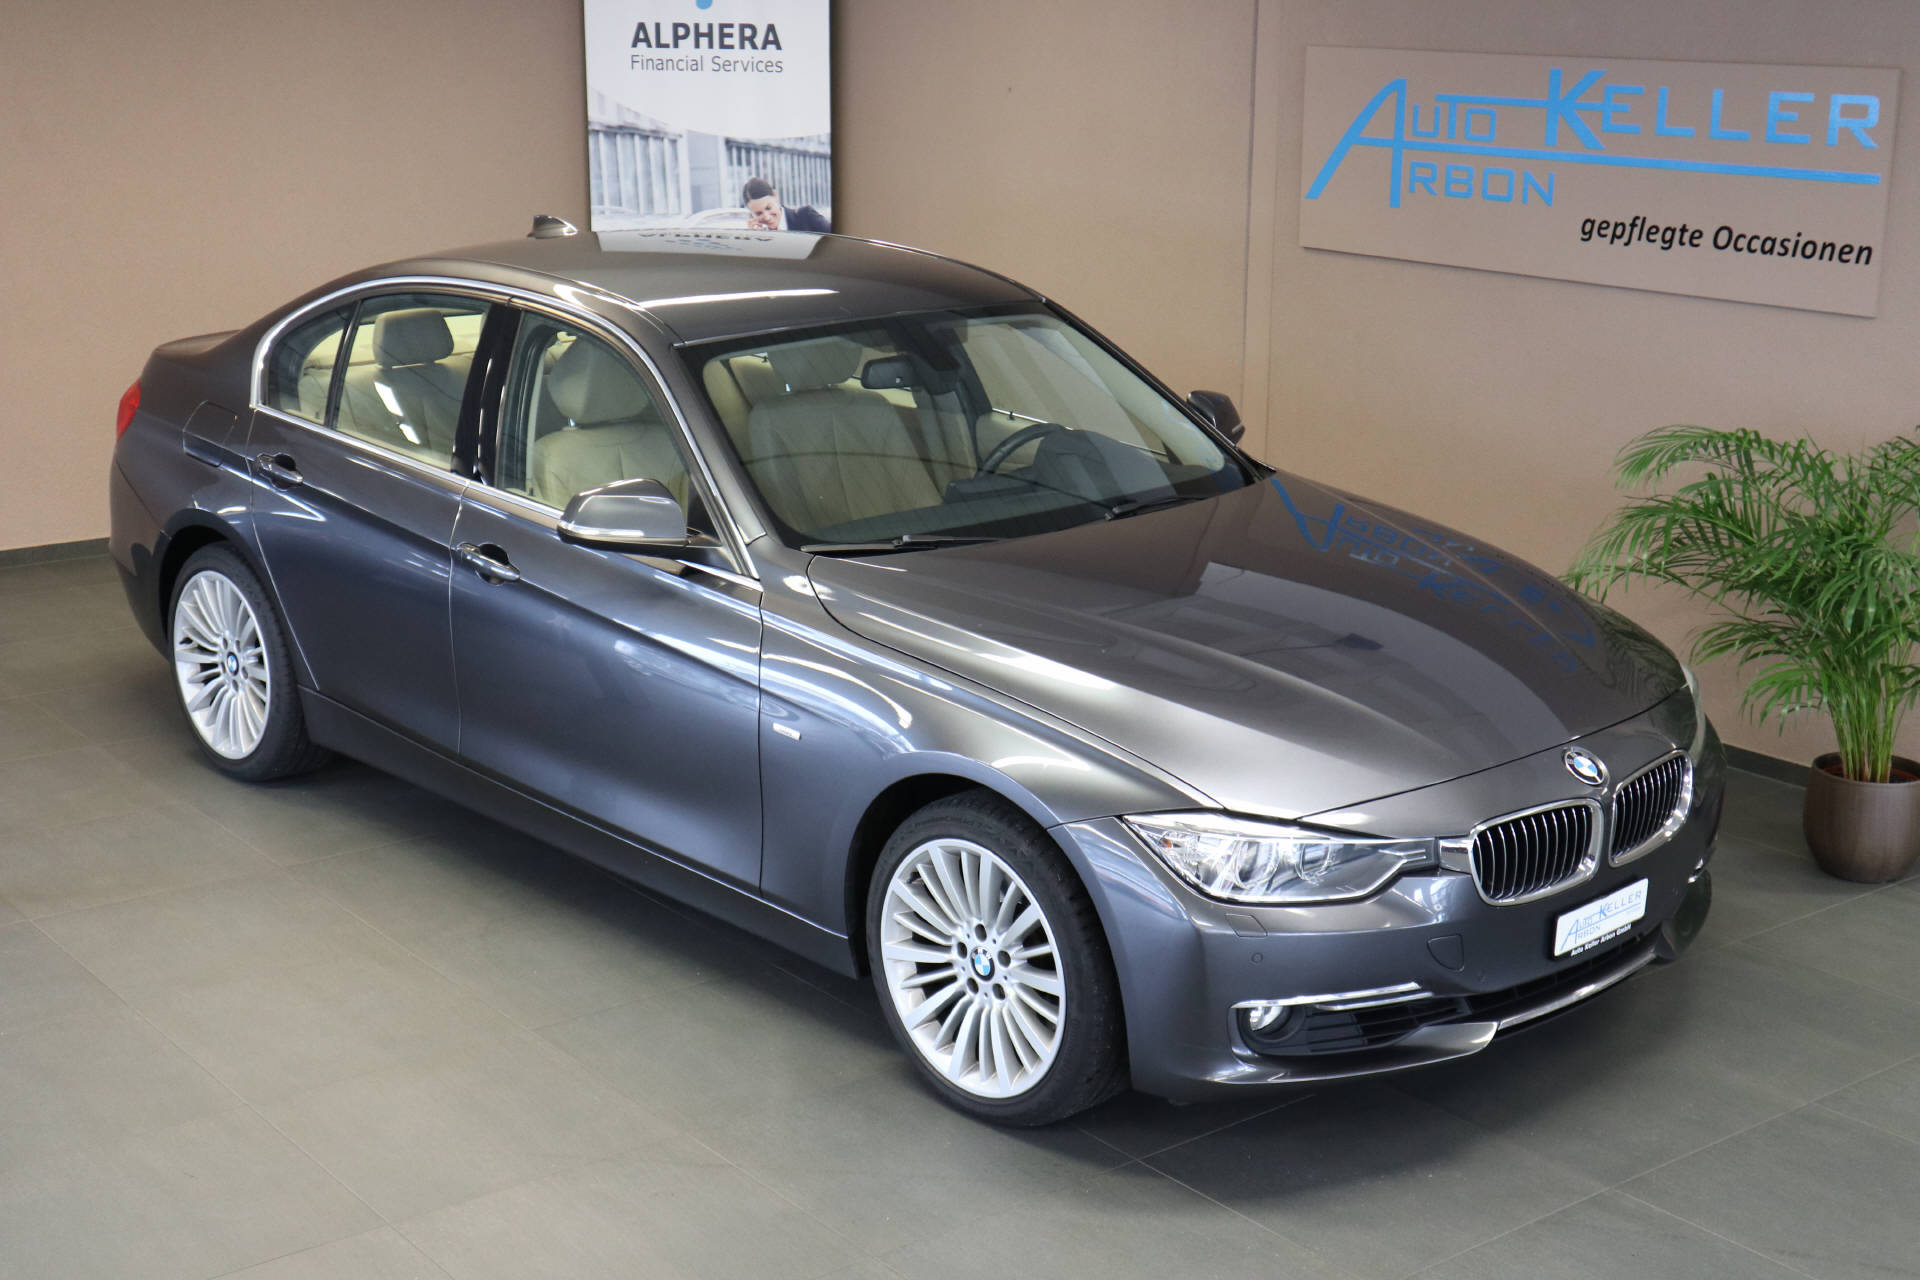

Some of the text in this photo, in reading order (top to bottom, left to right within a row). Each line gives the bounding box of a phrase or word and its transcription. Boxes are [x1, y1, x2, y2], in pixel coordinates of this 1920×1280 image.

[631, 22, 782, 50] ALPHERA
[631, 54, 783, 73] Financial Services
[1545, 68, 1880, 149] KELLER
[1580, 215, 1873, 265] gepflegte Occasionen
